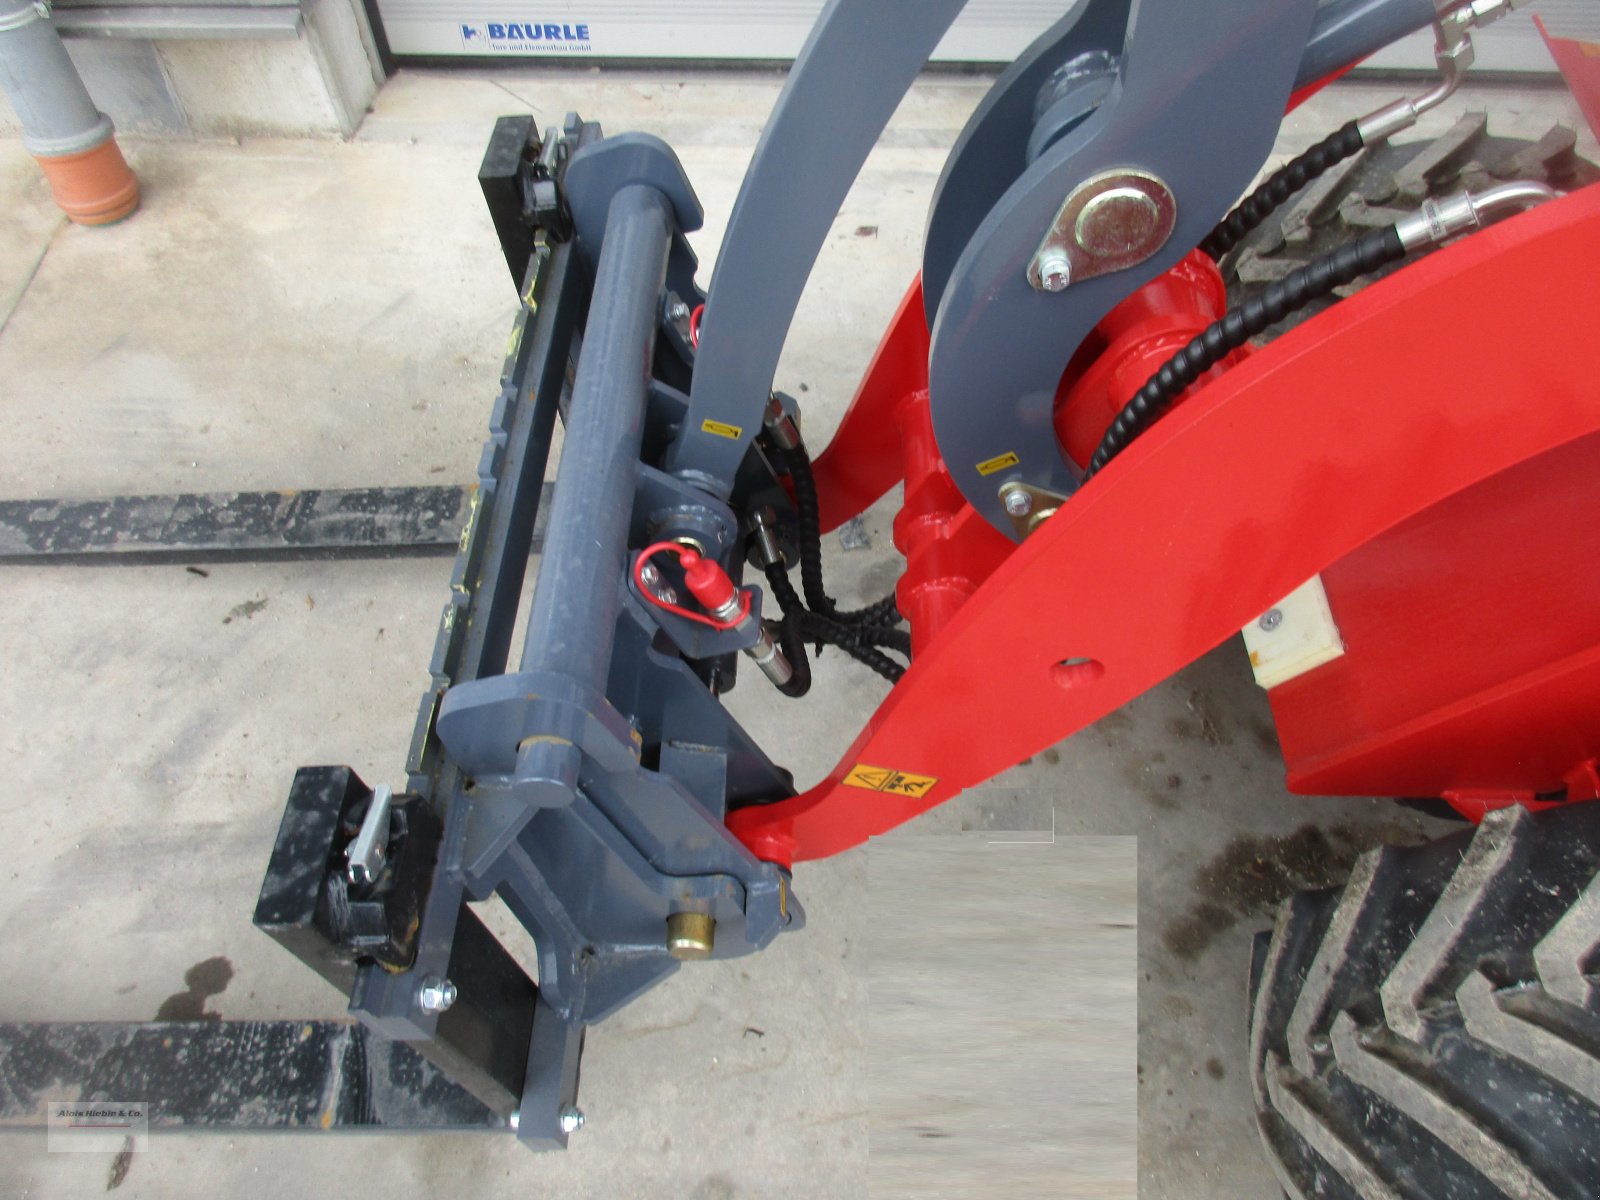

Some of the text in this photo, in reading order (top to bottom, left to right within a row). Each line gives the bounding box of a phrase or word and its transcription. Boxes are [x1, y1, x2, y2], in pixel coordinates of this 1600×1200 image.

[488, 23, 589, 40] BÄURLE
[509, 43, 523, 51] und
[569, 44, 592, 52] GmbH
